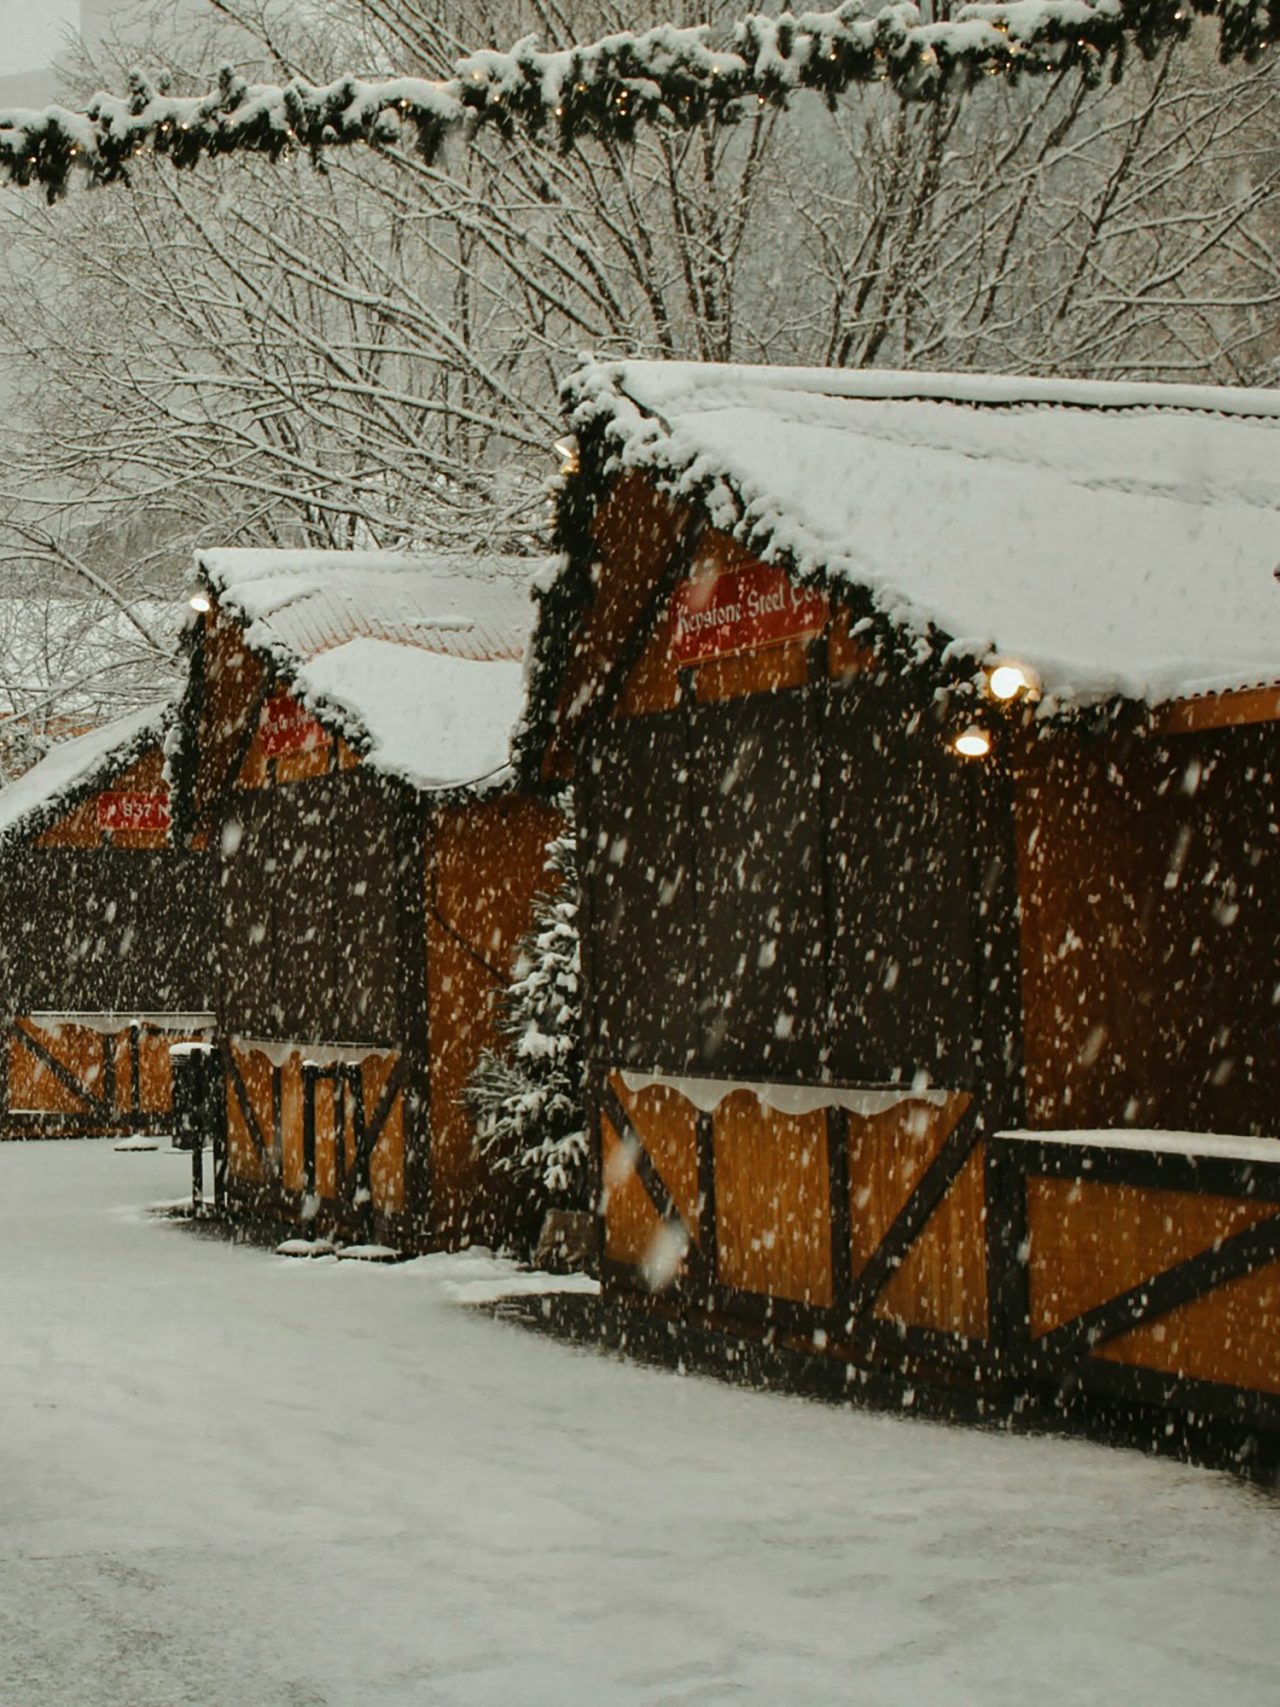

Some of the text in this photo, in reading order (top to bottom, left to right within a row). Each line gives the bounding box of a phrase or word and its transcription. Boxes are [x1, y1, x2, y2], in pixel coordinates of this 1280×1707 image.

[677, 582, 819, 635] Keystone Steel Co.
[122, 802, 152, 817] 837
